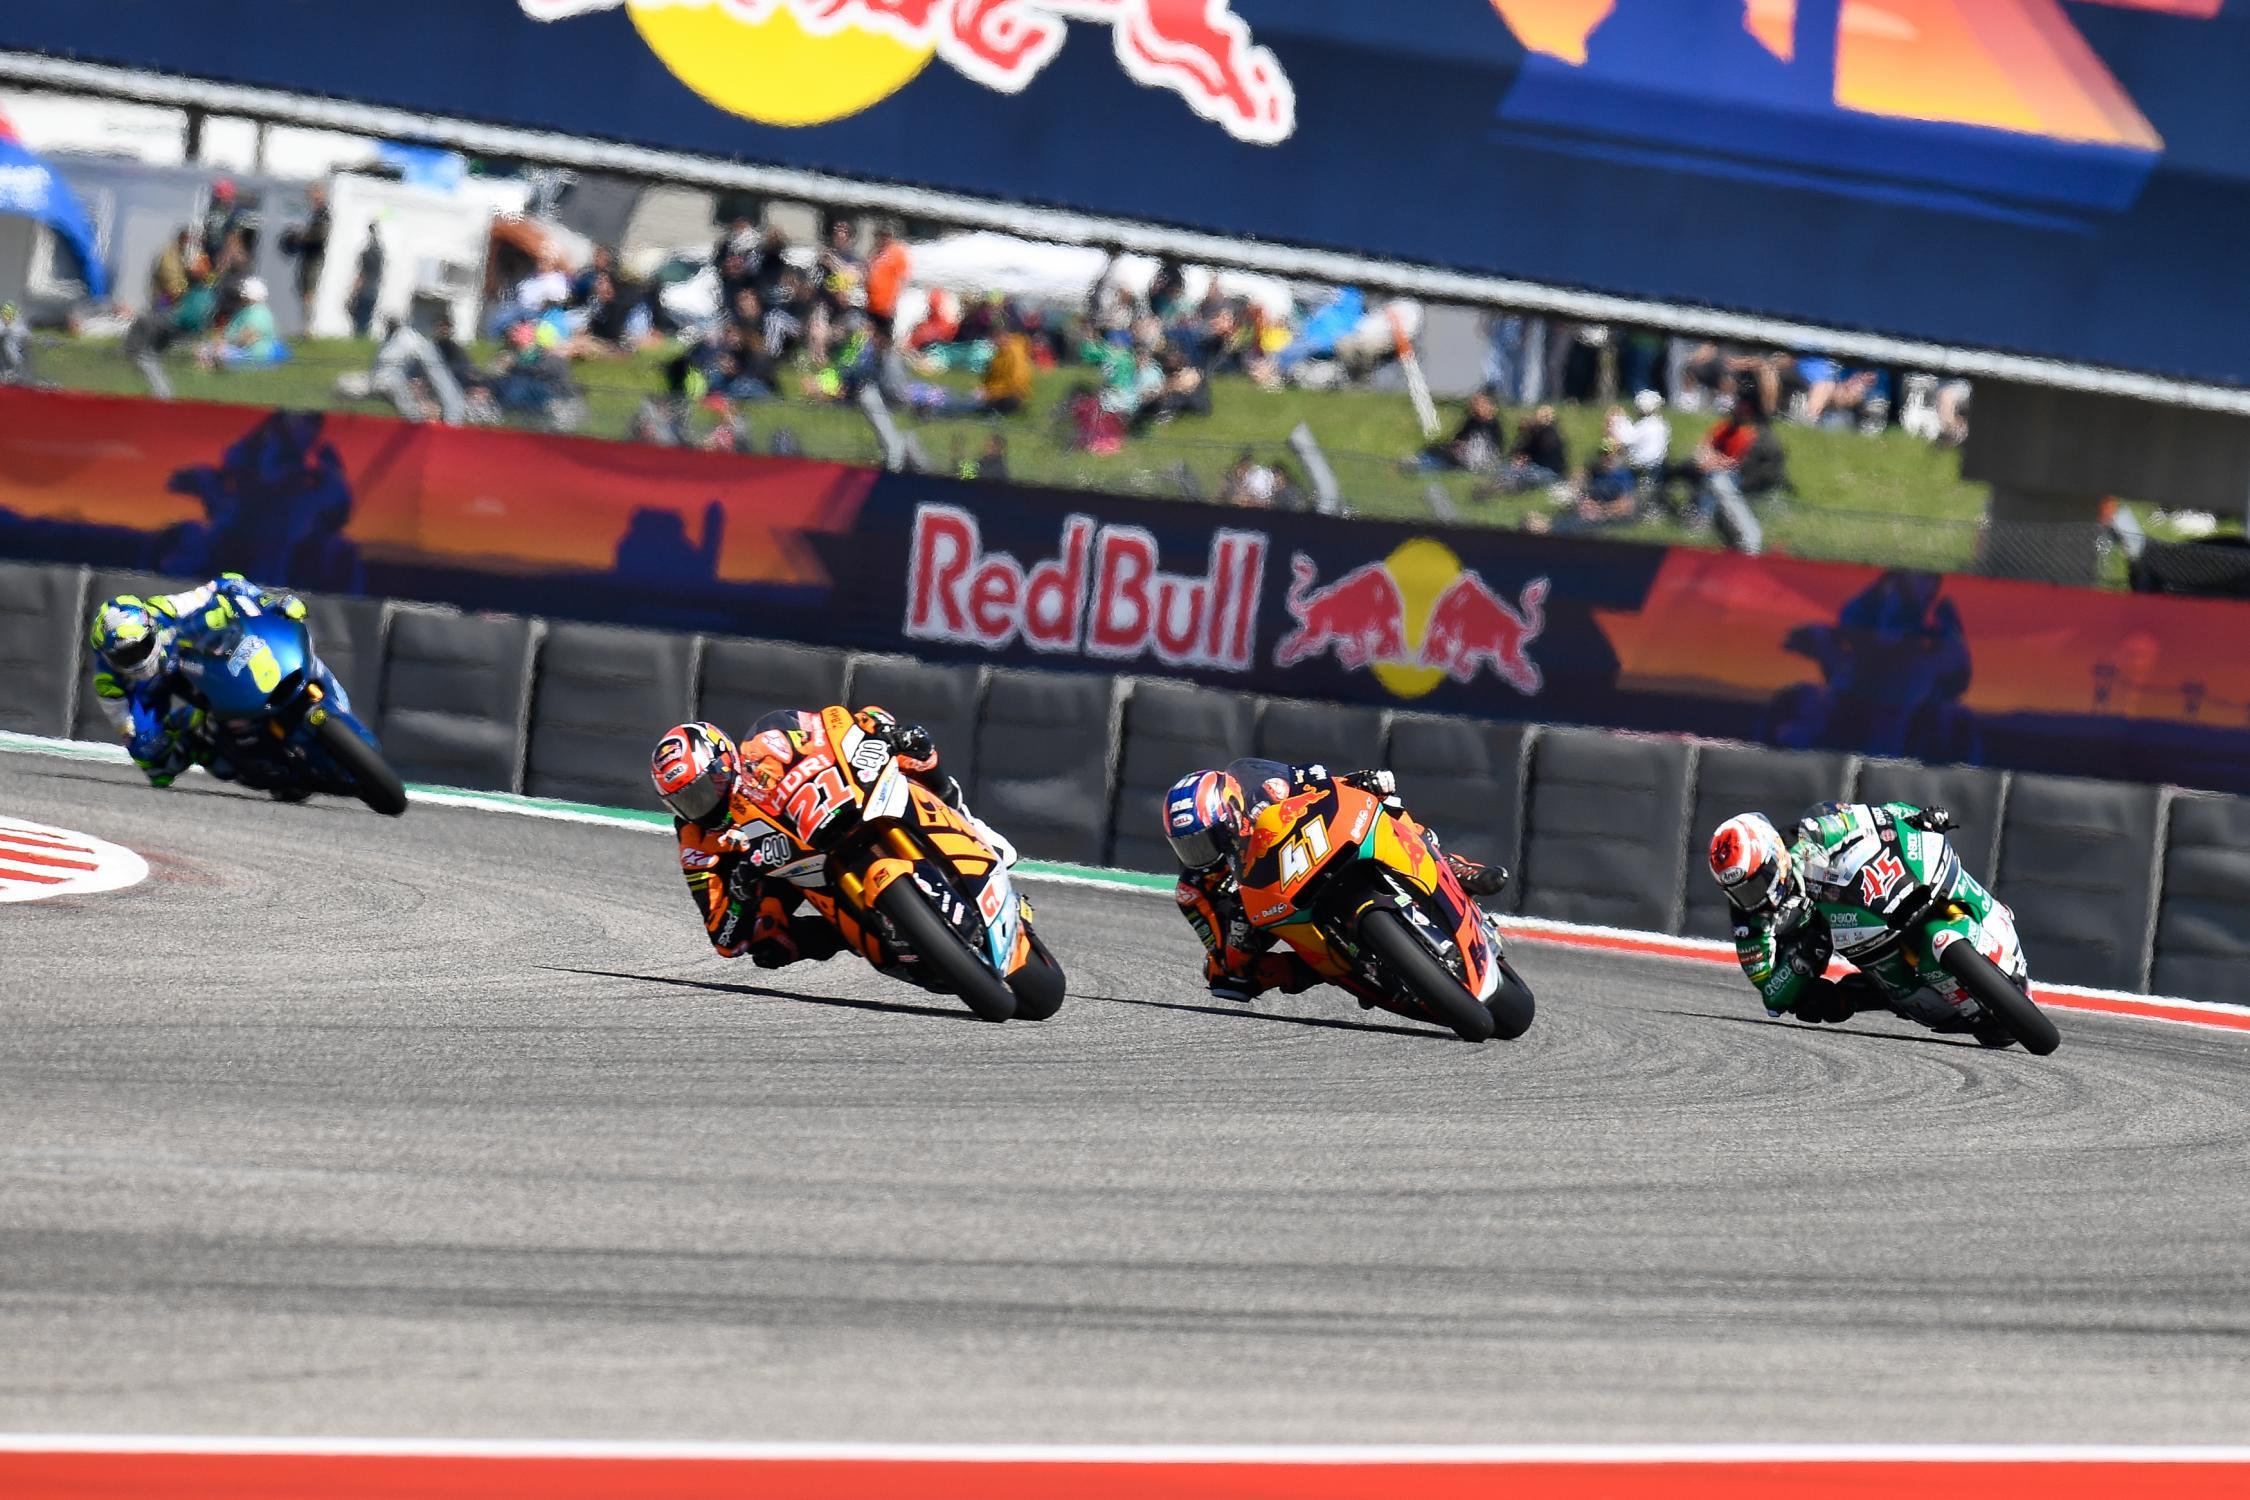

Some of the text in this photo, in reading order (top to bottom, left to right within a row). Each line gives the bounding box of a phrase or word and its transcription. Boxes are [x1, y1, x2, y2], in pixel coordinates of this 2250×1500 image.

[905, 503, 1267, 671] Red Bull
[786, 766, 855, 843] 21
[1279, 814, 1332, 892] 41
[1860, 847, 1906, 907] 45
